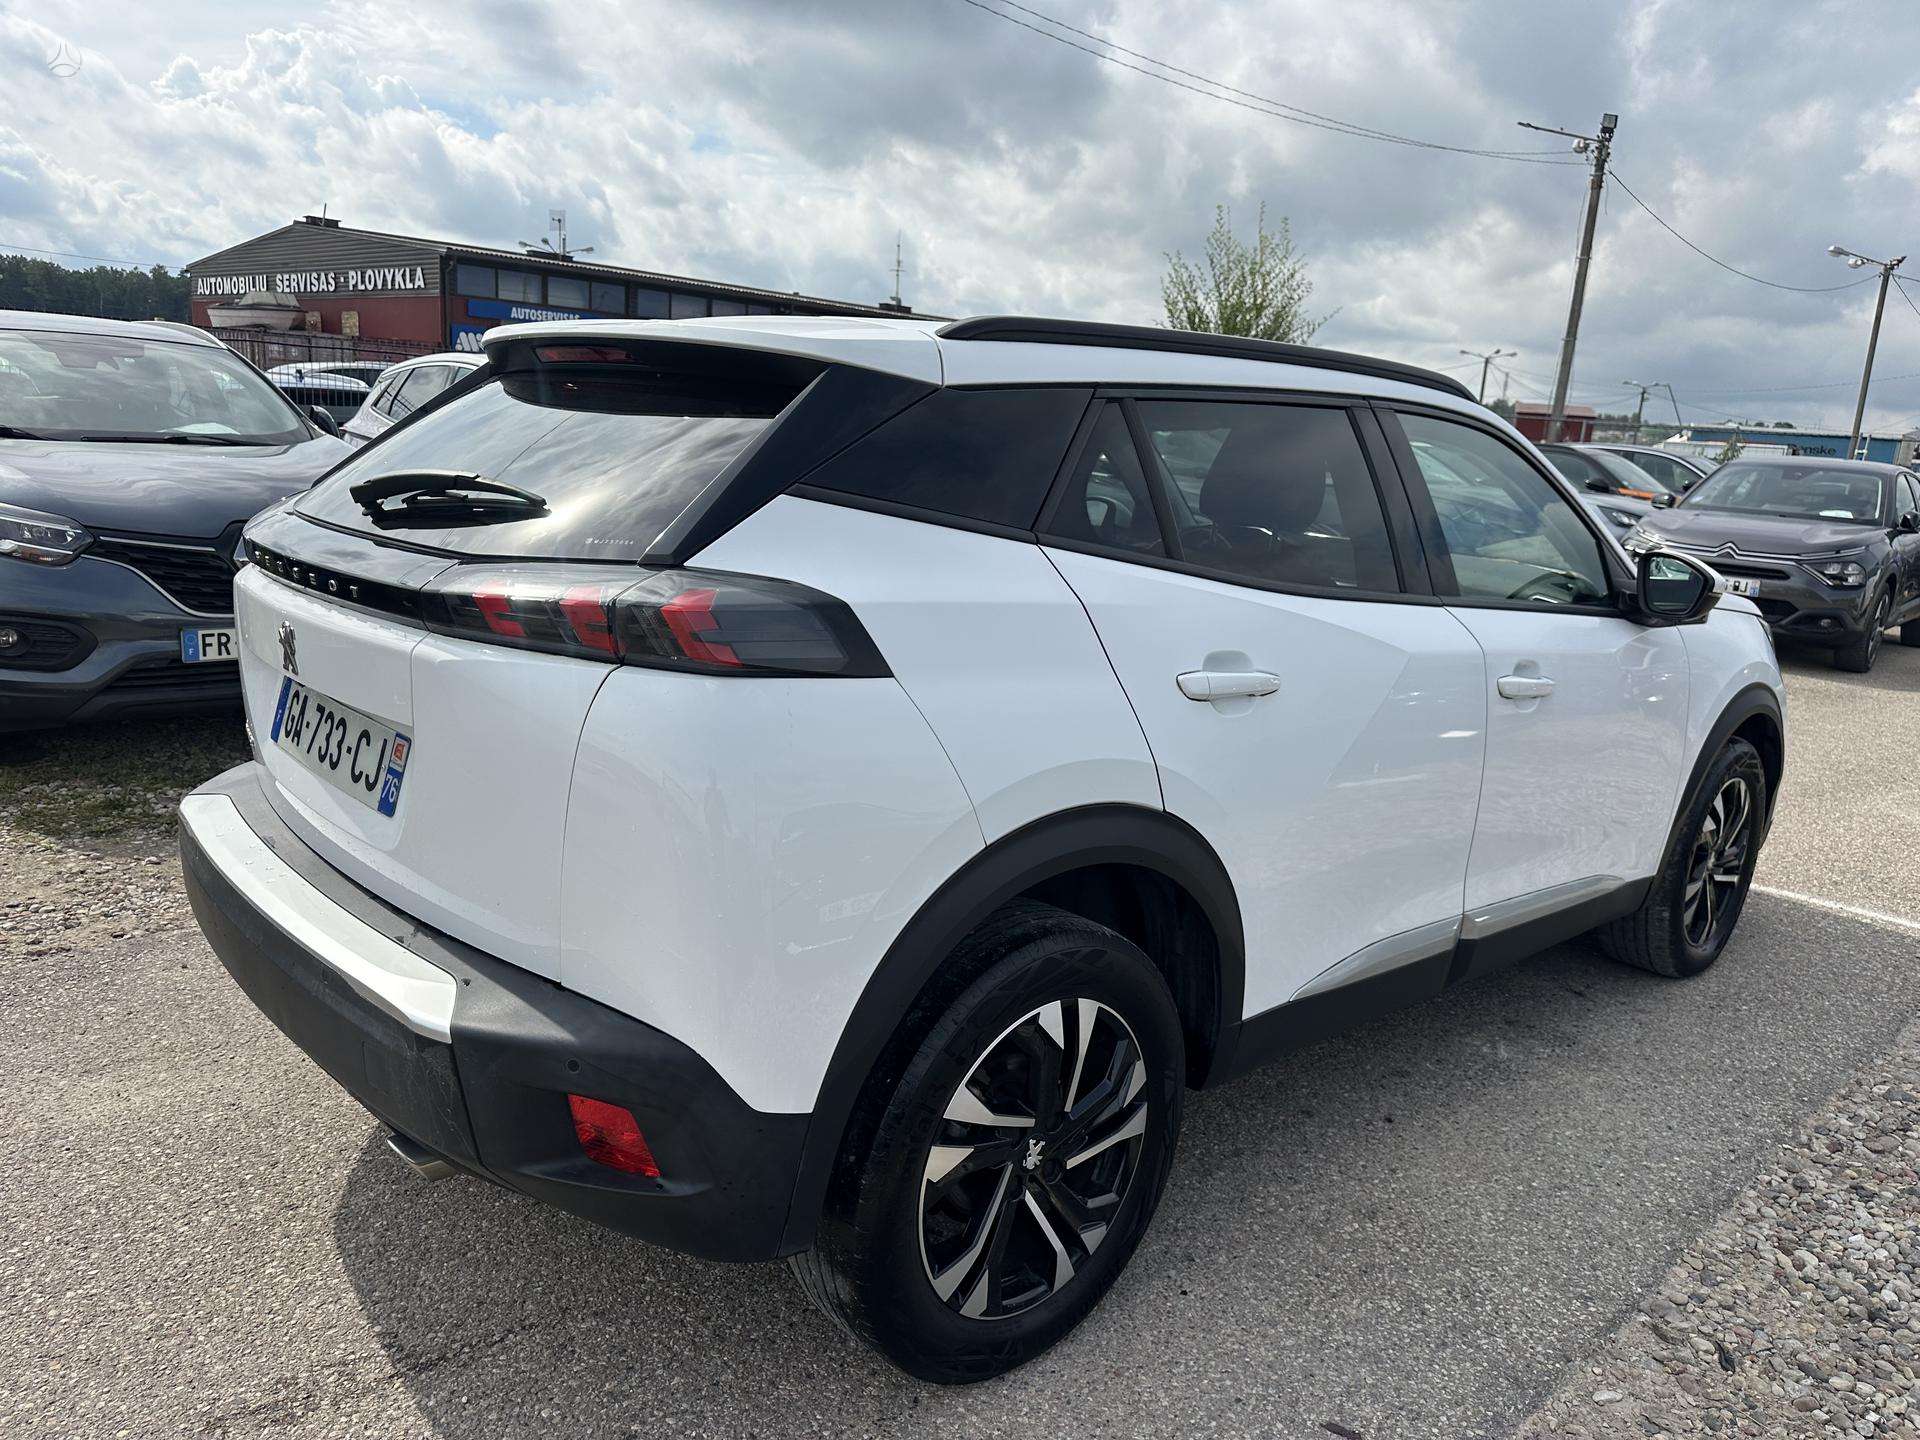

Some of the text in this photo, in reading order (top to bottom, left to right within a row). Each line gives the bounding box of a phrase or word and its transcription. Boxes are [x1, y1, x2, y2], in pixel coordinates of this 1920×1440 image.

[275, 271, 336, 293] SERVISAS
[348, 266, 425, 291] PLOVYKLA
[284, 689, 388, 793] GA-733-CJ
[381, 775, 399, 803] 76
